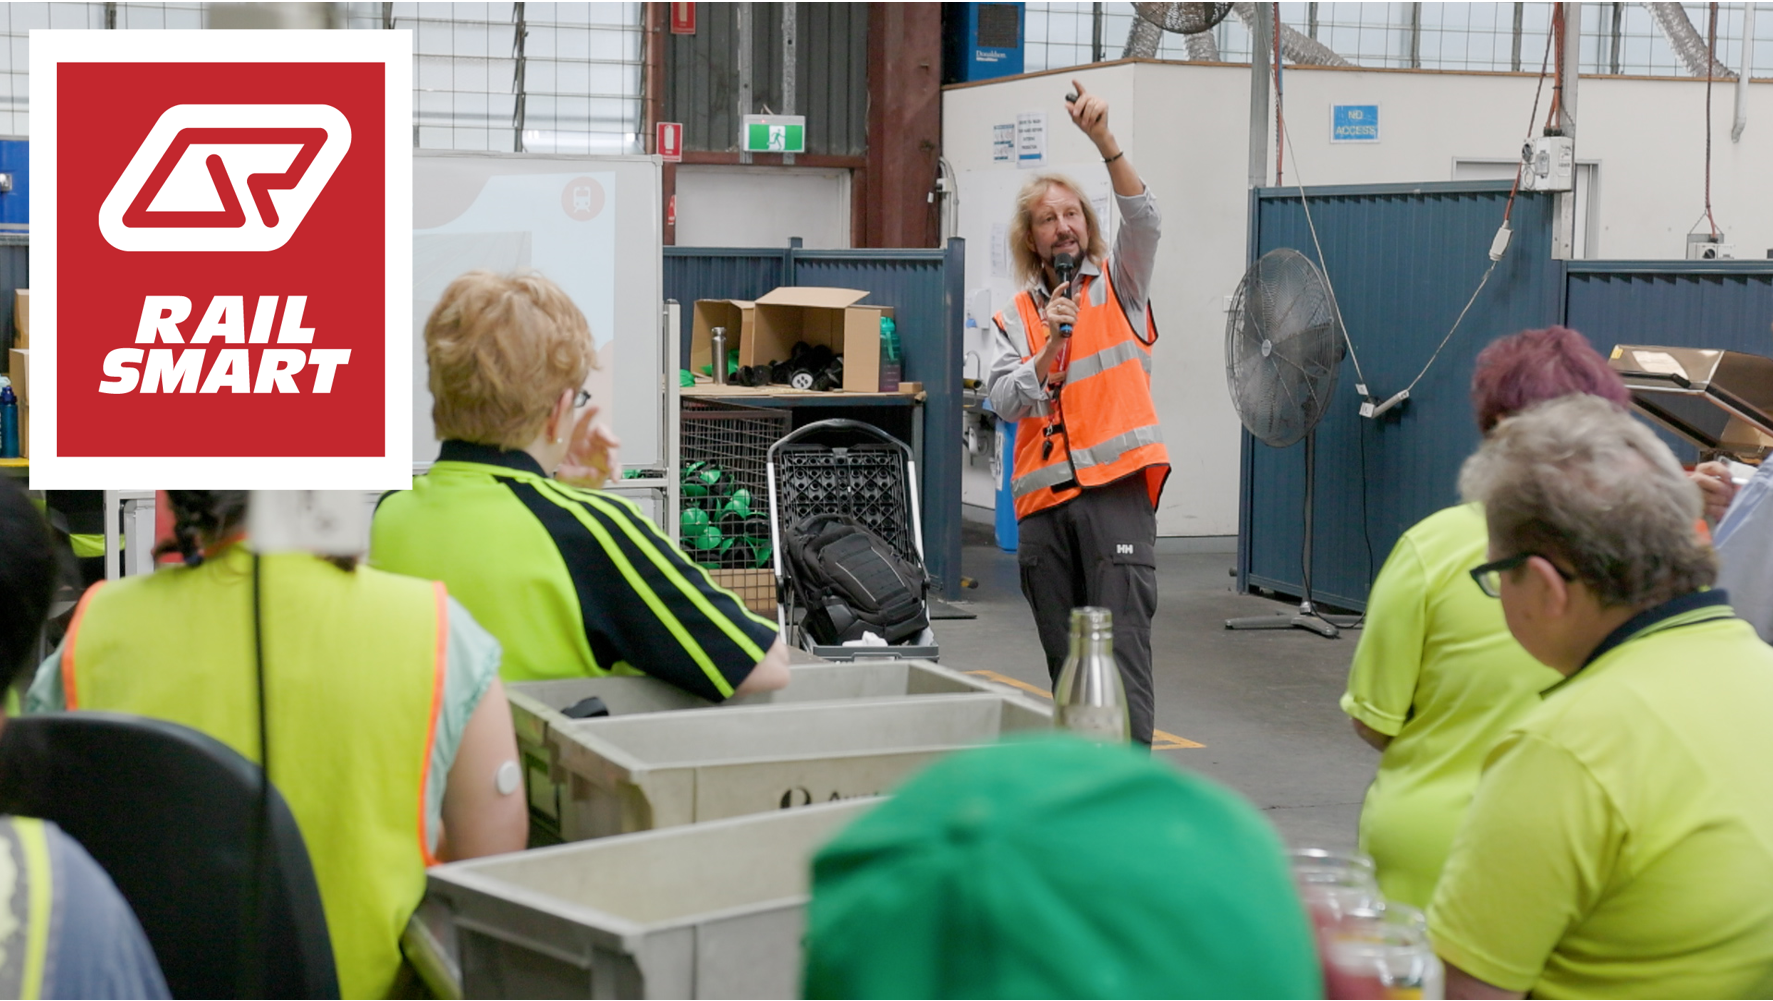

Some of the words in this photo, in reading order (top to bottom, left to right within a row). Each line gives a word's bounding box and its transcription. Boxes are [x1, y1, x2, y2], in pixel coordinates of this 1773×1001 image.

[1348, 110, 1363, 119] NO
[1336, 125, 1376, 135] ACCESS
[1116, 543, 1133, 554] HH
